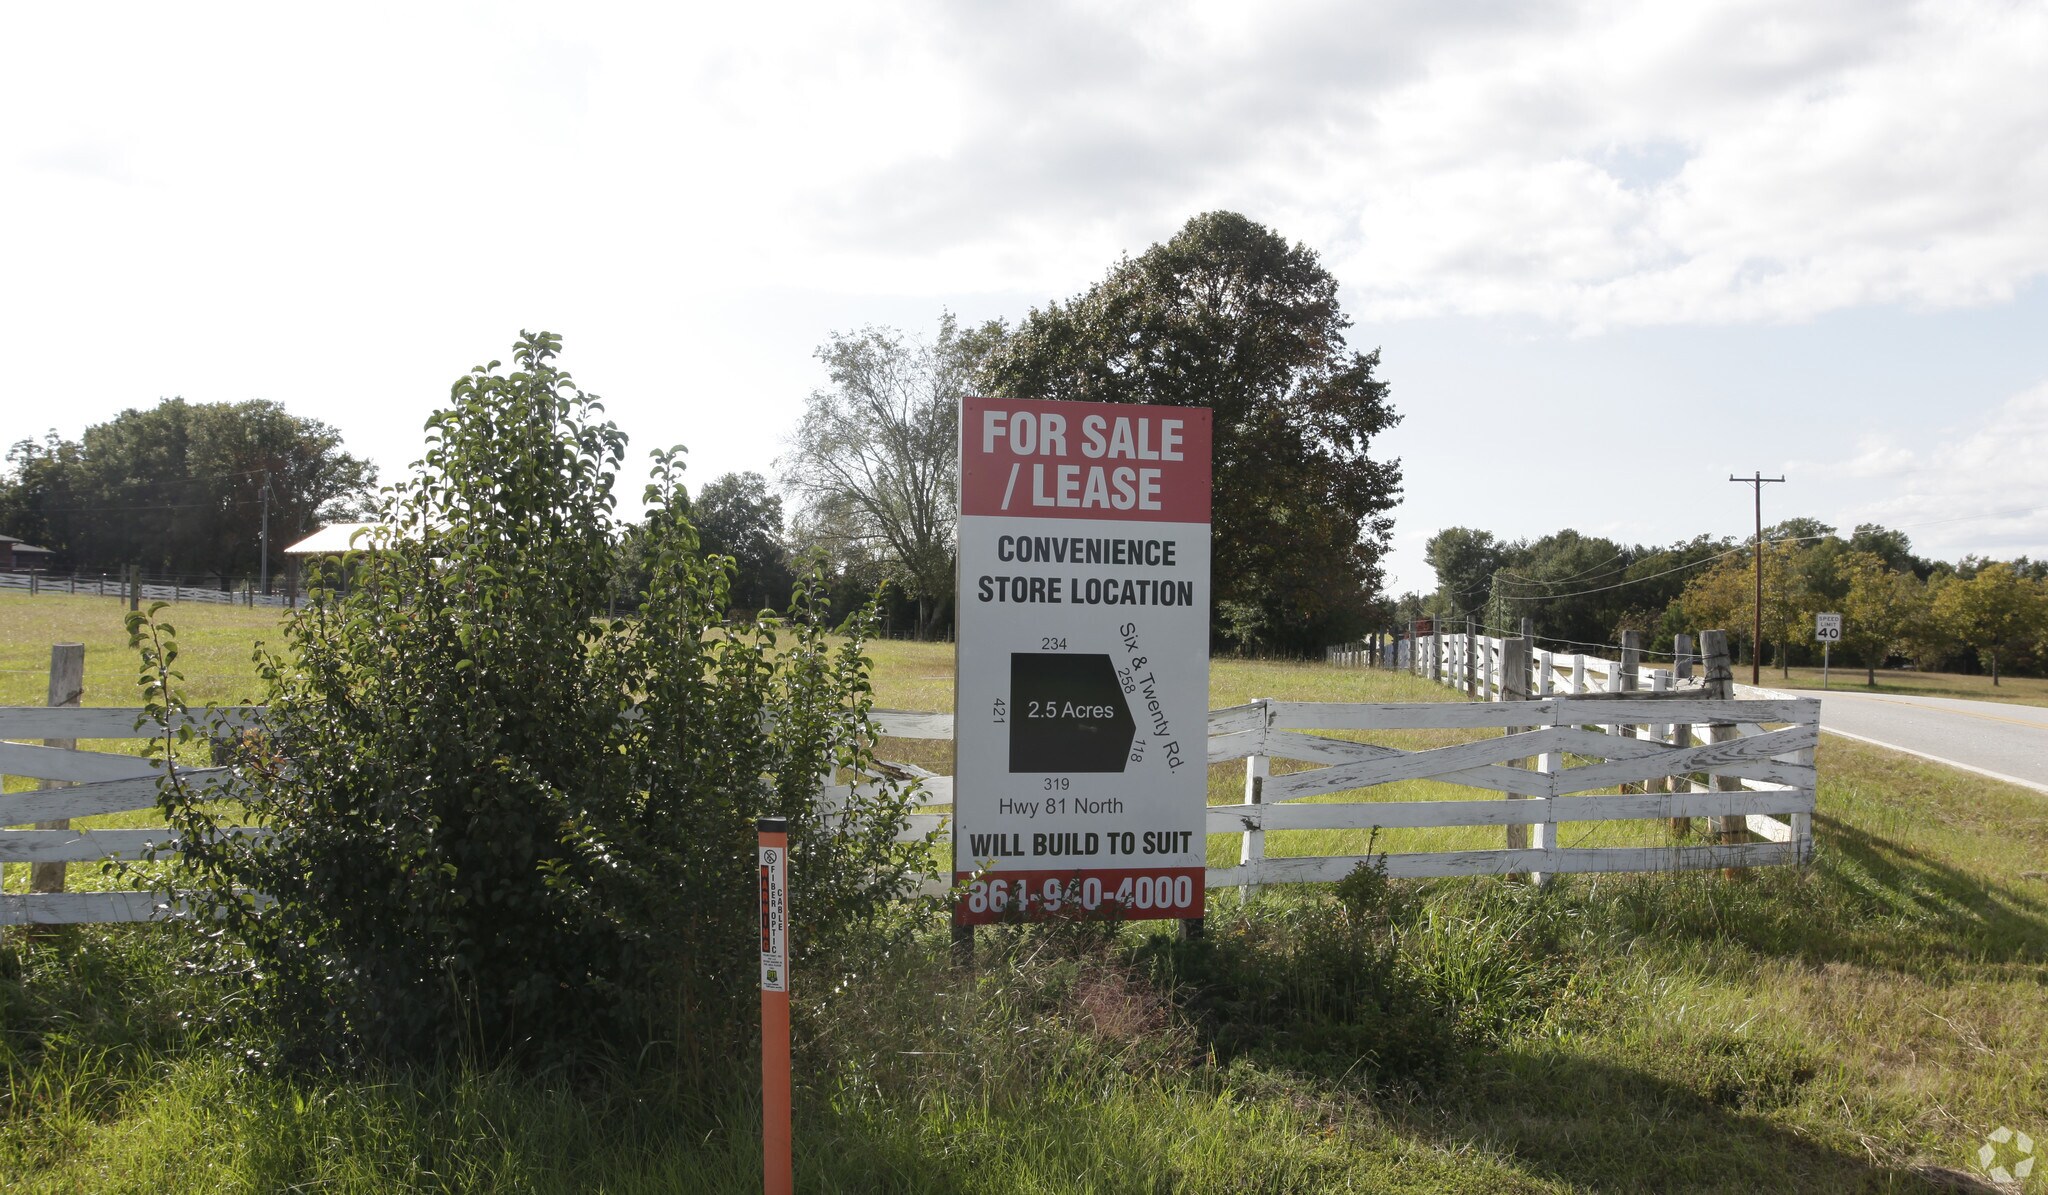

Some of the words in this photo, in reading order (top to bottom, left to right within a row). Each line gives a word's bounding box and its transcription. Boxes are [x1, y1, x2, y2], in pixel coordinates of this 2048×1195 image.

[983, 410, 1067, 456] FOR
[1081, 414, 1184, 461] SALE
[1000, 463, 1020, 510] /
[1032, 463, 1161, 511] LEASE
[998, 535, 1176, 566] CONVENIENCE
[977, 575, 1062, 604] STORE
[1071, 577, 1193, 606] LOCATION
[1041, 637, 1067, 650] 234
[1119, 622, 1139, 653] Six
[1818, 628, 1838, 638] 40
[1132, 656, 1148, 671] &
[1118, 667, 1136, 694] 258
[993, 698, 1006, 724] 421
[1027, 701, 1058, 719] 2.5
[1061, 701, 1114, 719] Acres
[1139, 672, 1170, 736] Twenty
[1130, 739, 1147, 763] 118
[1162, 741, 1184, 774] Rd.
[1043, 777, 1070, 791] 319
[999, 798, 1039, 818] Hwy
[1045, 798, 1066, 815] 81
[1074, 798, 1123, 815] North
[969, 833, 1025, 856] WILL
[1032, 832, 1099, 856] BUILD
[1107, 832, 1135, 855] TO
[1142, 831, 1193, 854] SUIT
[761, 866, 770, 952] WARNING
